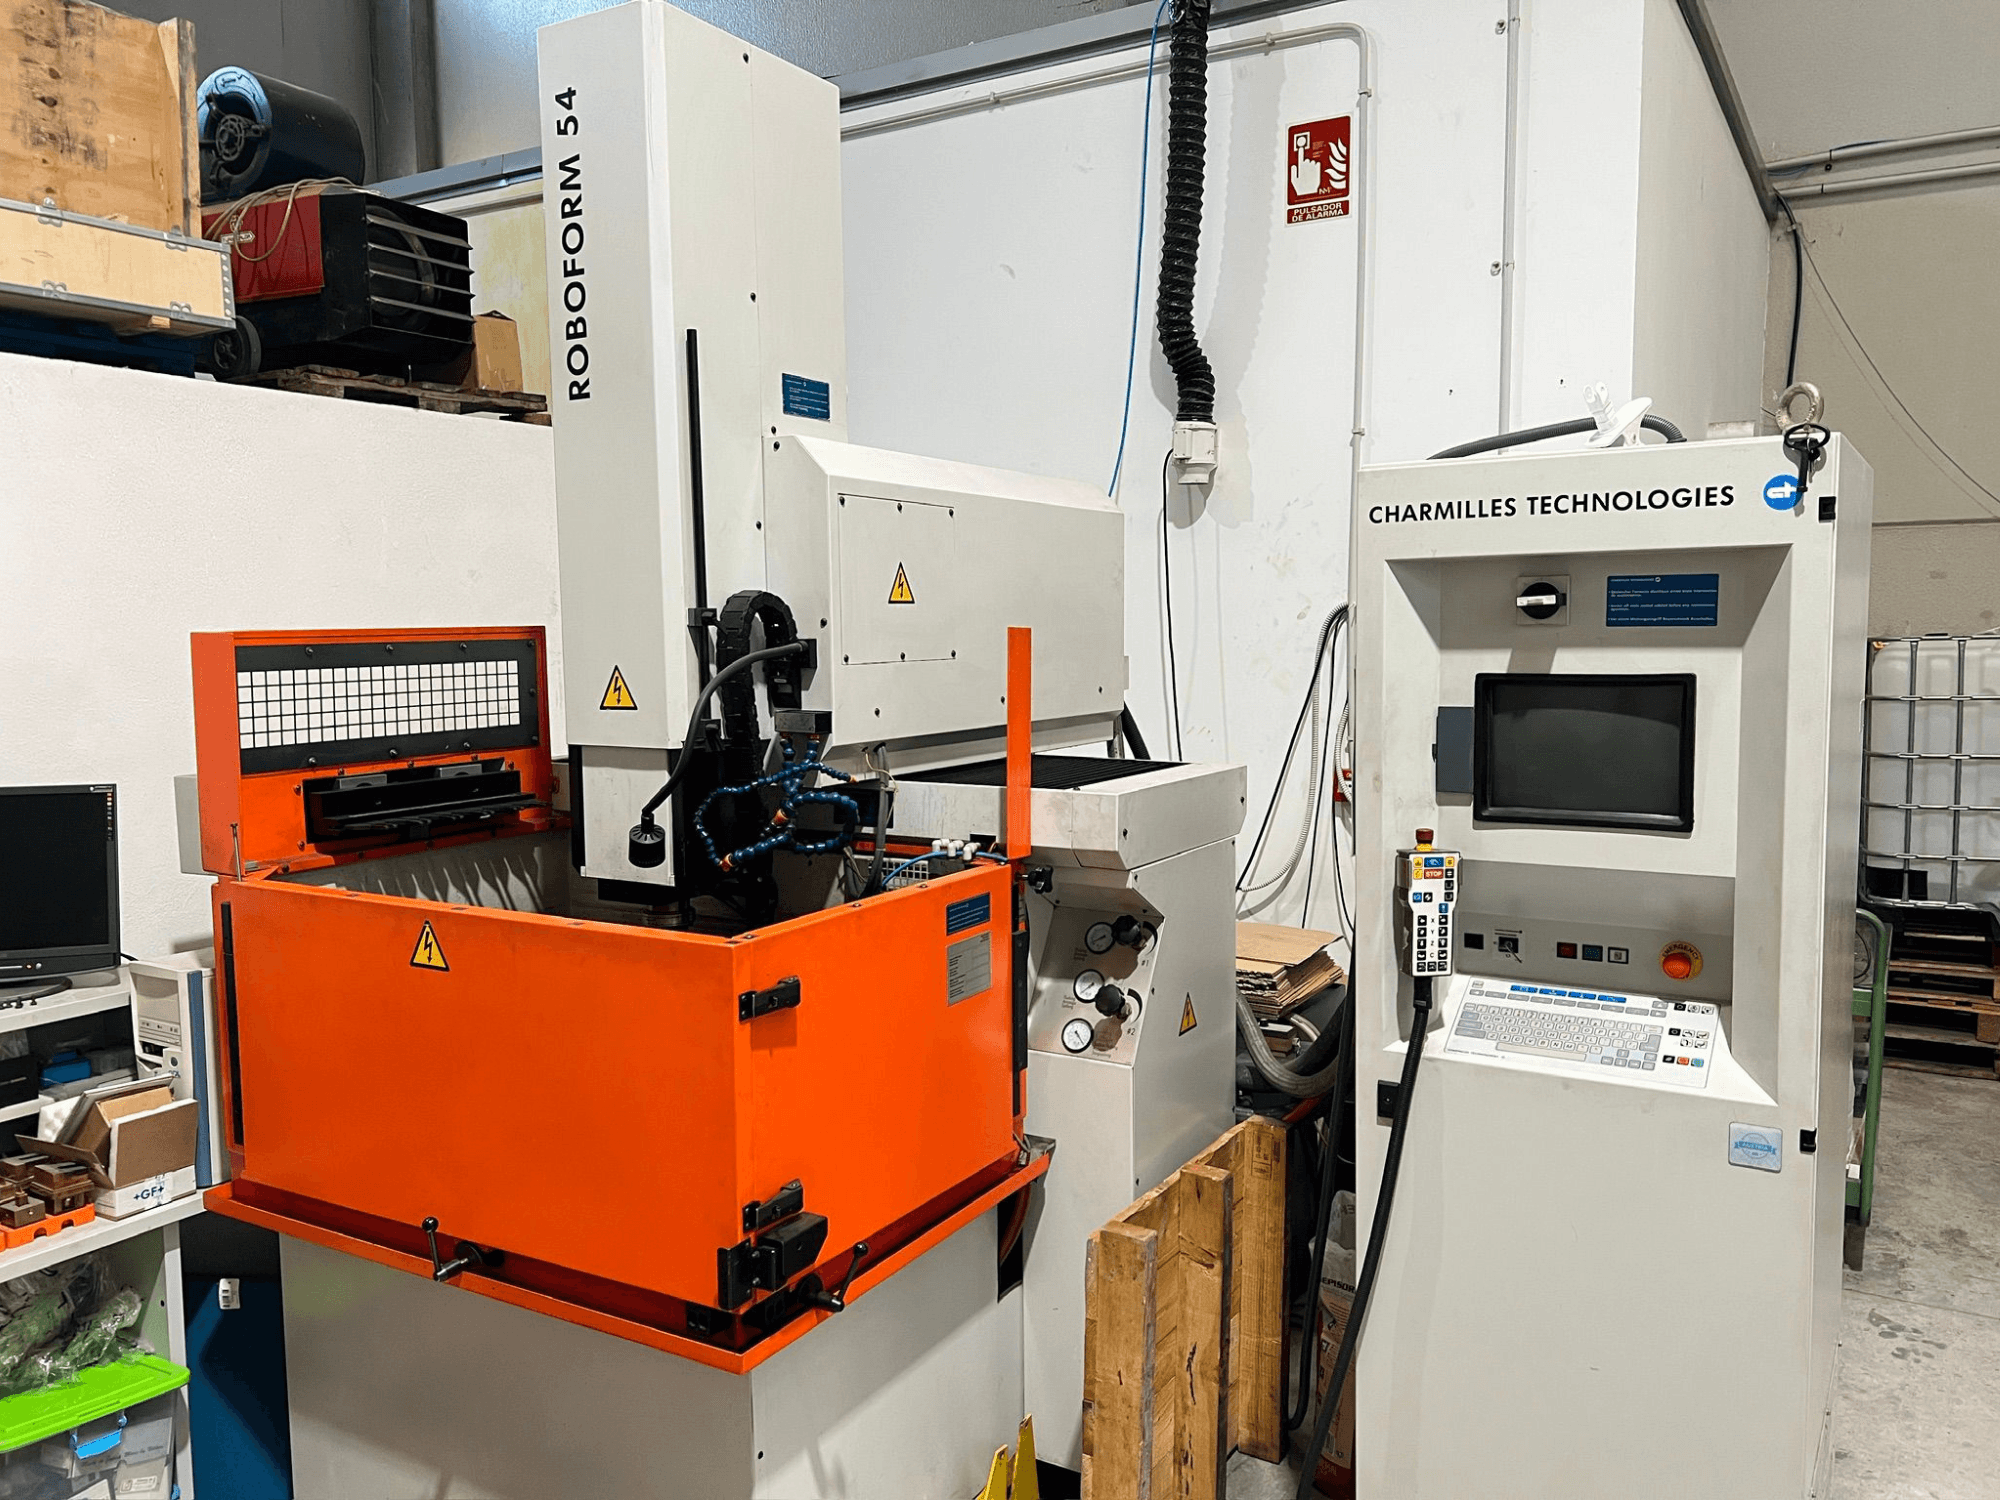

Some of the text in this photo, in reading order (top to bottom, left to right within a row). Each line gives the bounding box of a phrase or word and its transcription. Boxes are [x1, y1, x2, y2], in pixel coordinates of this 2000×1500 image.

[1294, 203, 1342, 215] PULSADOR
[1306, 209, 1344, 220] ALARMA
[554, 86, 591, 401] ROBOFORM 54
[1369, 485, 1735, 524] CHARMILLES TECHNOLOGIES
